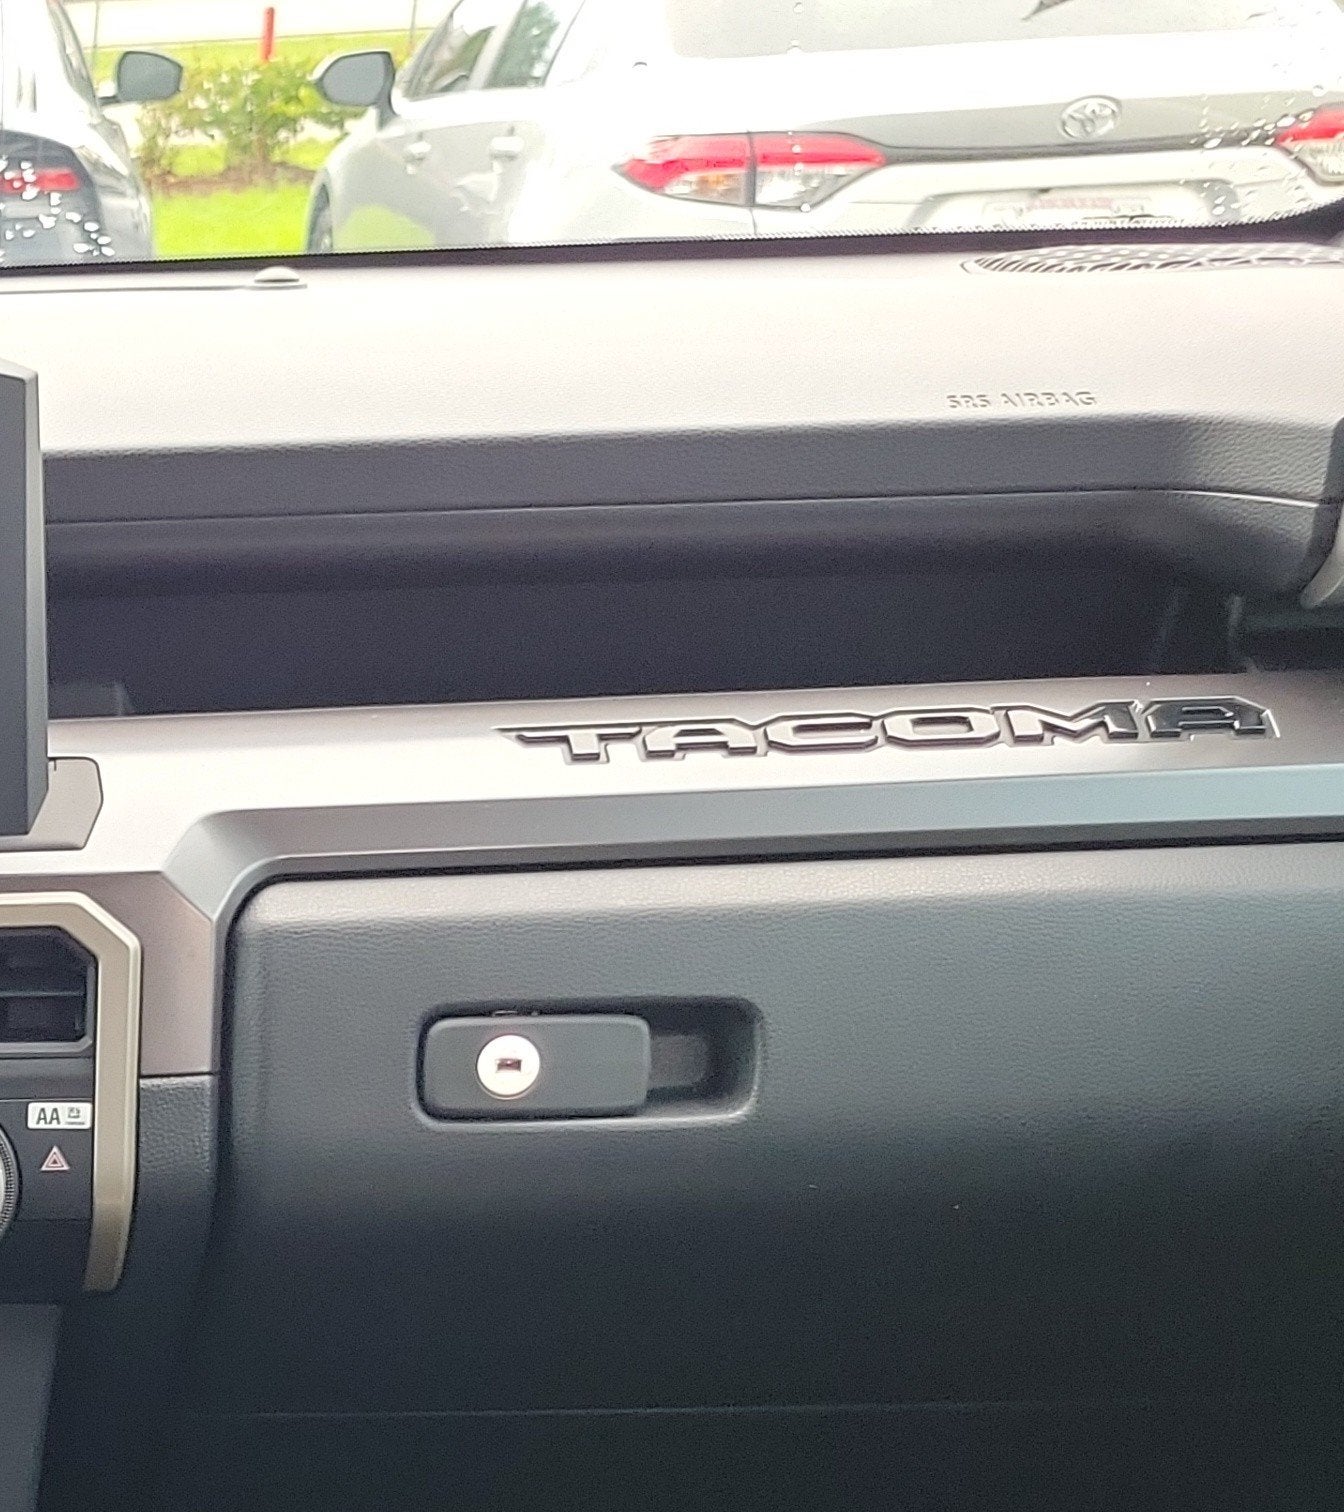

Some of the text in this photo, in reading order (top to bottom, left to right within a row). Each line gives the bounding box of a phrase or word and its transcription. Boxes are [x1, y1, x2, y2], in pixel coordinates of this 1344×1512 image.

[946, 391, 1097, 408] SRS AIRBAG
[502, 697, 1275, 762] TACOMA
[35, 1107, 61, 1125] AA
